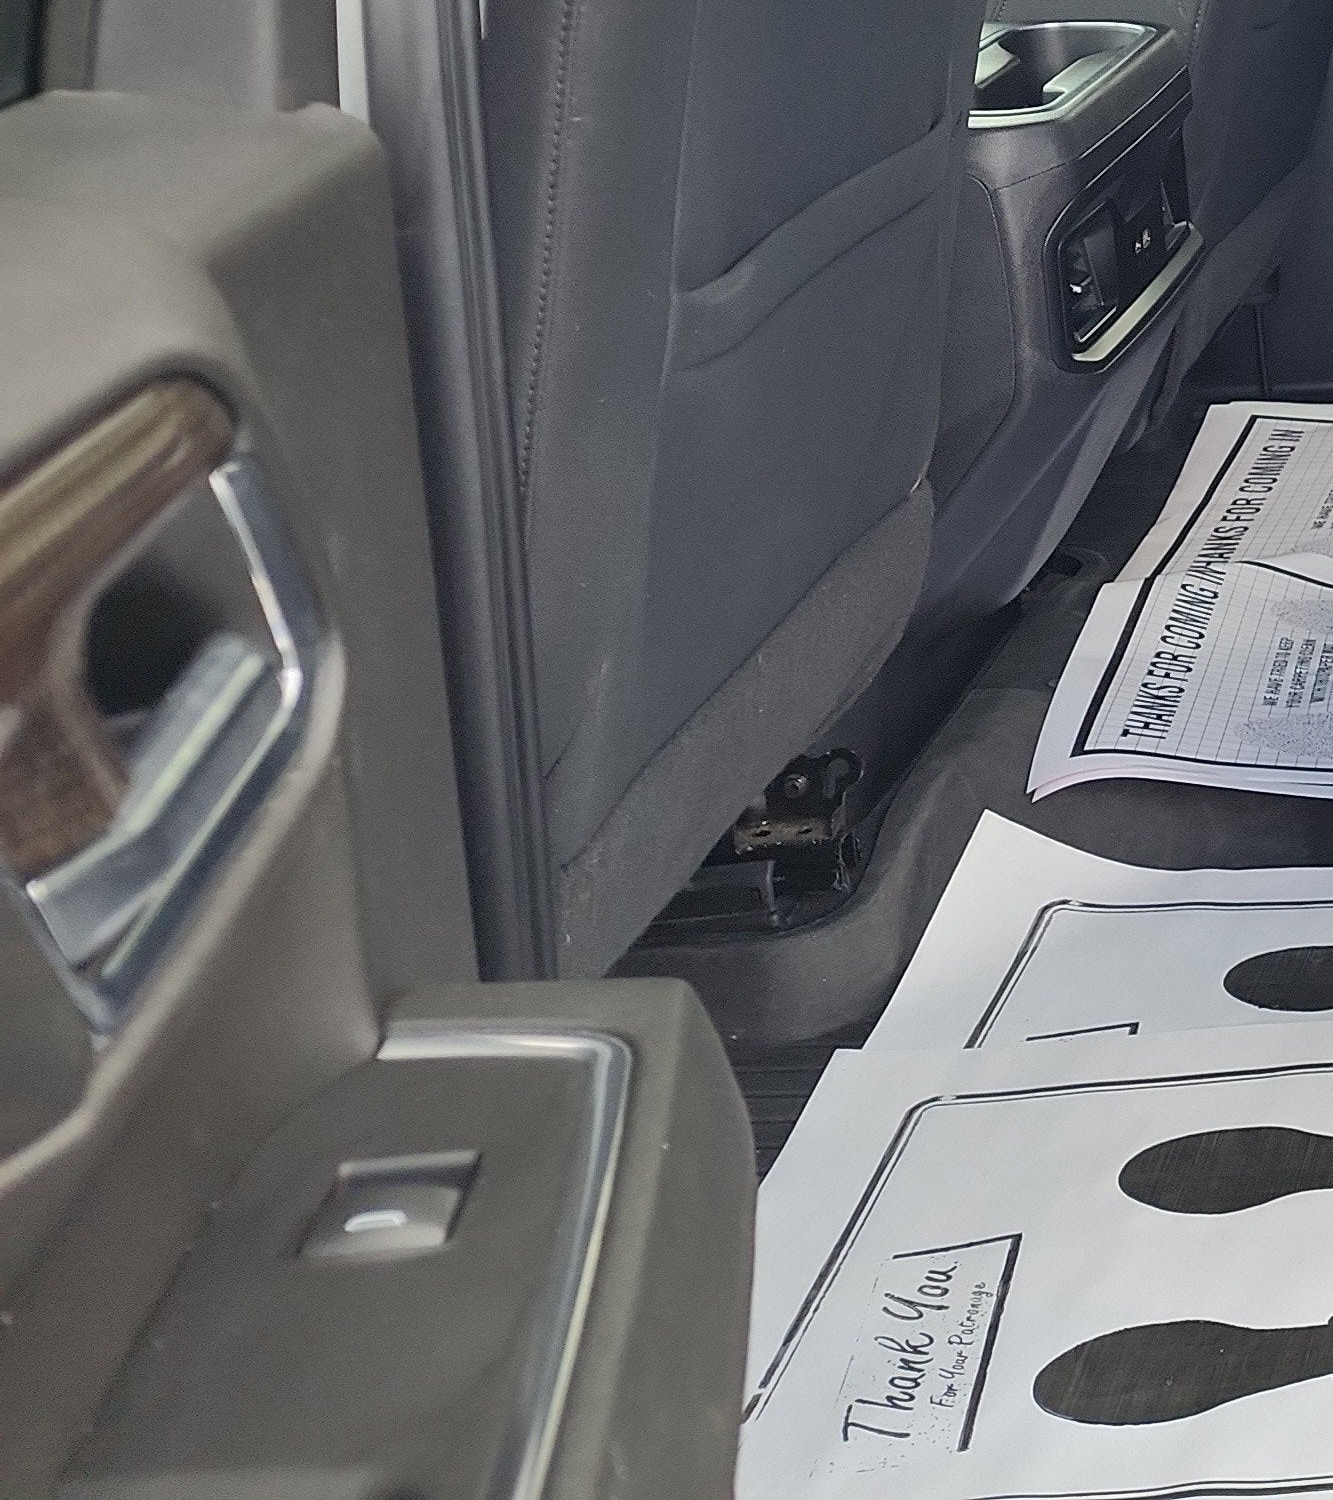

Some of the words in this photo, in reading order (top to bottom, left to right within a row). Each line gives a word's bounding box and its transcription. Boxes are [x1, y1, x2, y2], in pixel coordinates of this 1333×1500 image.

[1269, 429, 1305, 442] IN
[1239, 444, 1296, 493] COMING
[1221, 497, 1267, 522] FOR
[1190, 526, 1249, 569] HANKS
[1185, 568, 1226, 586] IN
[1160, 583, 1219, 650] COMING
[1147, 651, 1197, 682] FOR
[1119, 682, 1185, 740] THANKS
[882, 1265, 958, 1321] You
[938, 1350, 969, 1379] Your
[842, 1332, 934, 1442] Thank
[930, 1384, 958, 1408] For
